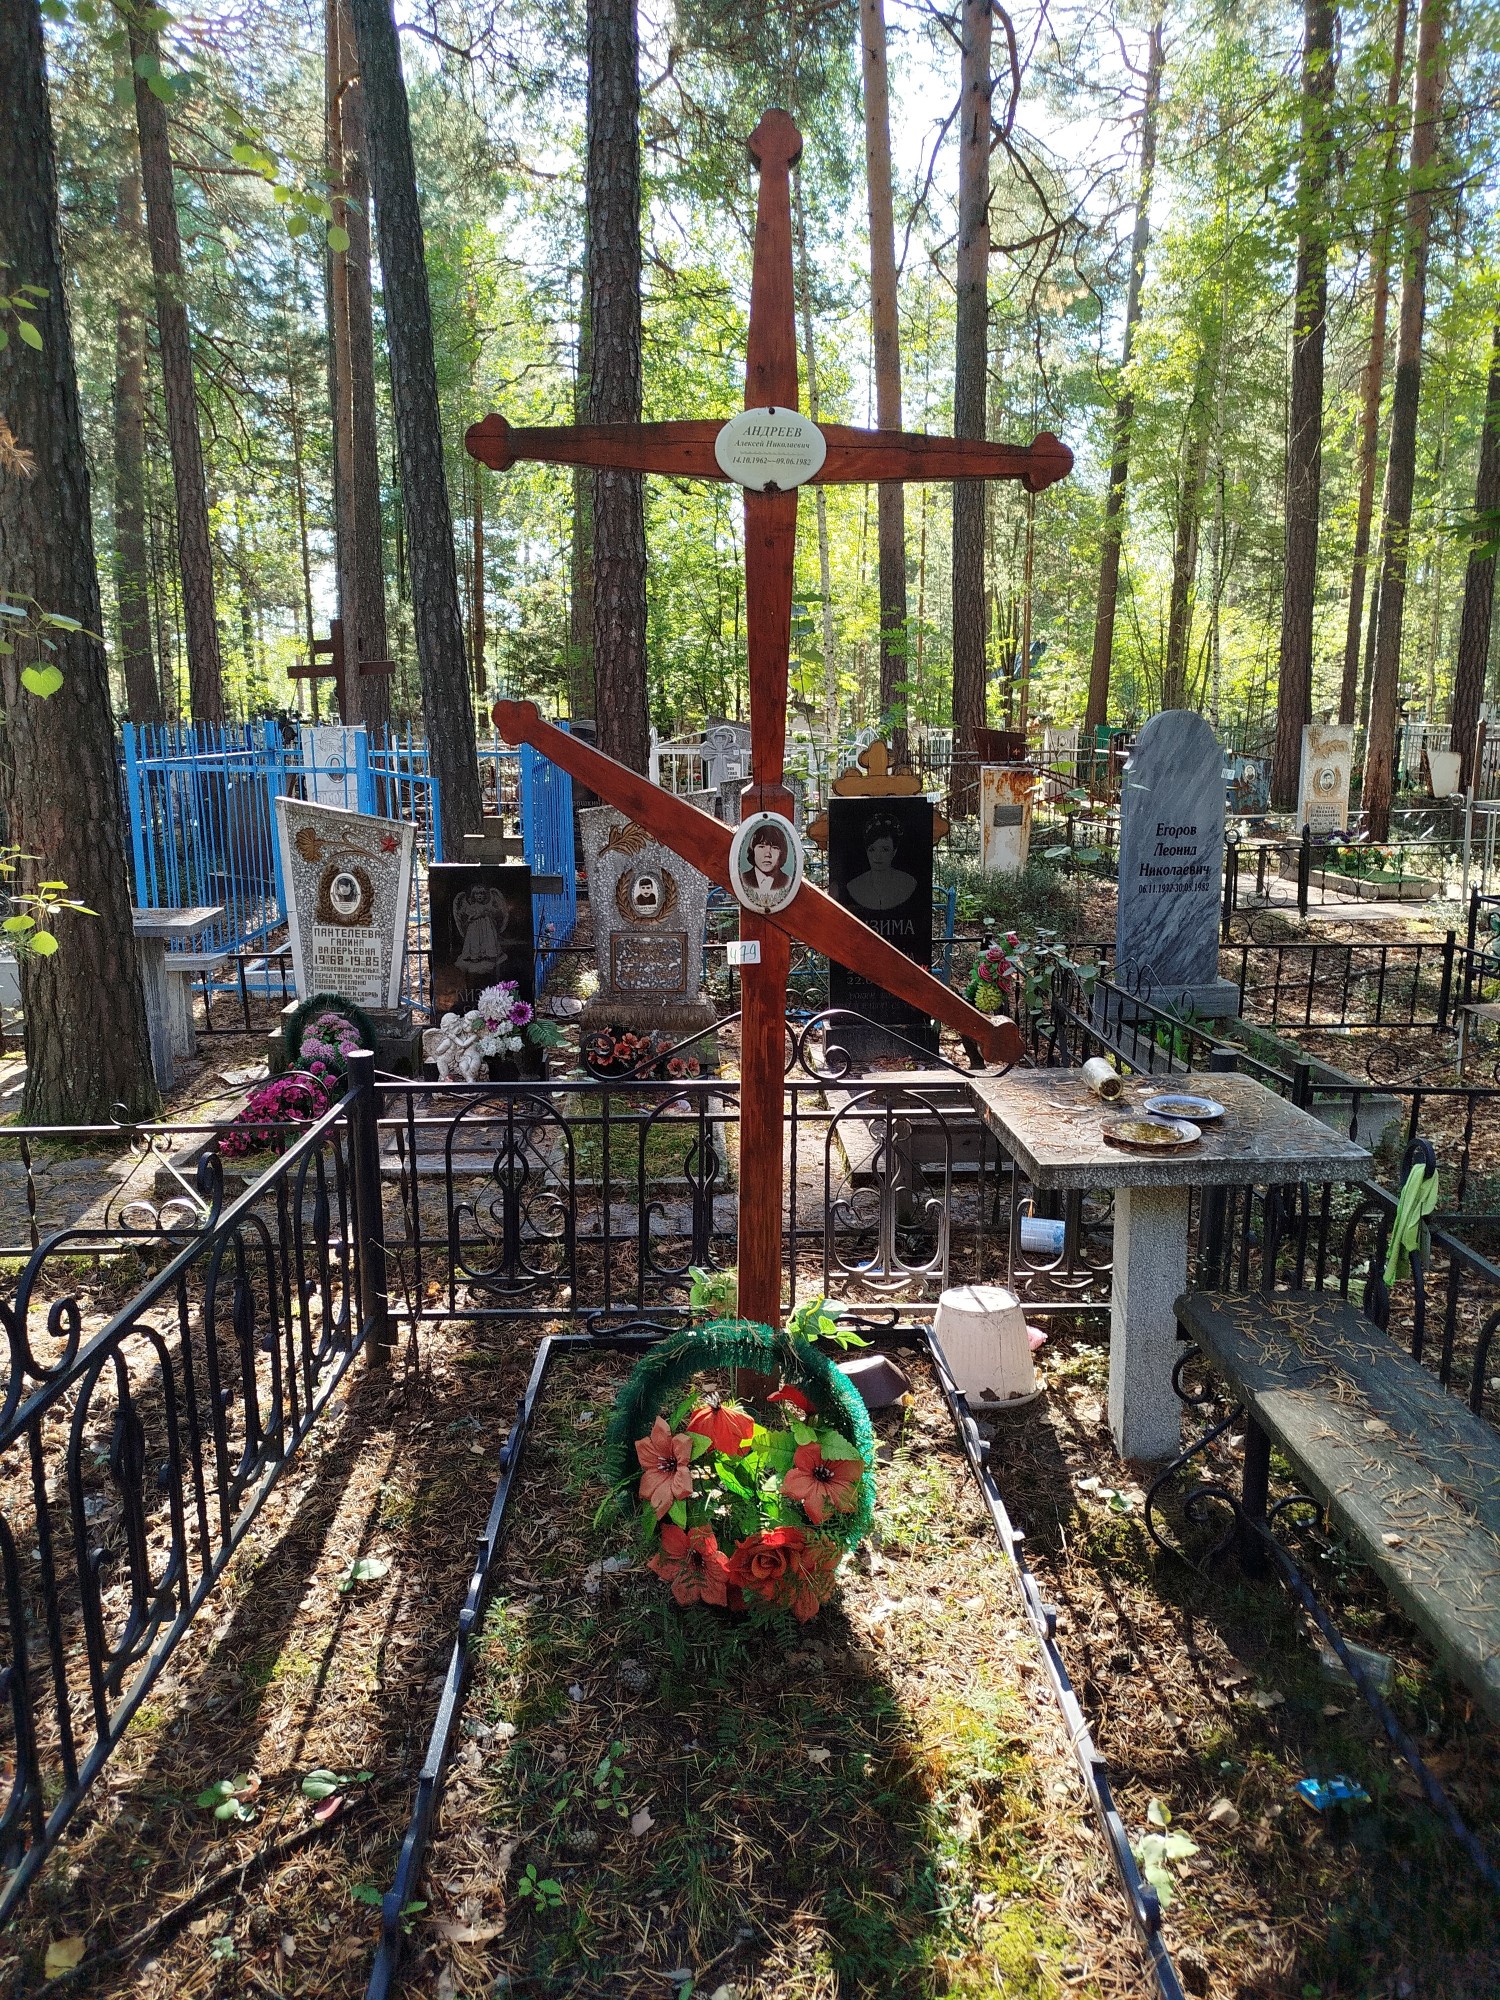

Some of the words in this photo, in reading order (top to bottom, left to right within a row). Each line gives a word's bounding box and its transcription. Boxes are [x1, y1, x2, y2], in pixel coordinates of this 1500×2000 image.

[742, 426, 803, 438] АНДРЕЕВ
[734, 440, 765, 448] Алексей
[766, 441, 810, 449] Николаевич
[1156, 822, 1197, 839] Егоров
[1153, 842, 1198, 857] Леонид
[1139, 863, 1210, 877] Николаевич
[314, 928, 381, 939] ПАНТЕЛЕЕВА
[866, 919, 916, 936] ЗИМА
[330, 938, 365, 947] ГАЛИНА
[318, 946, 376, 956] ВАЛЕРЬЕВНА
